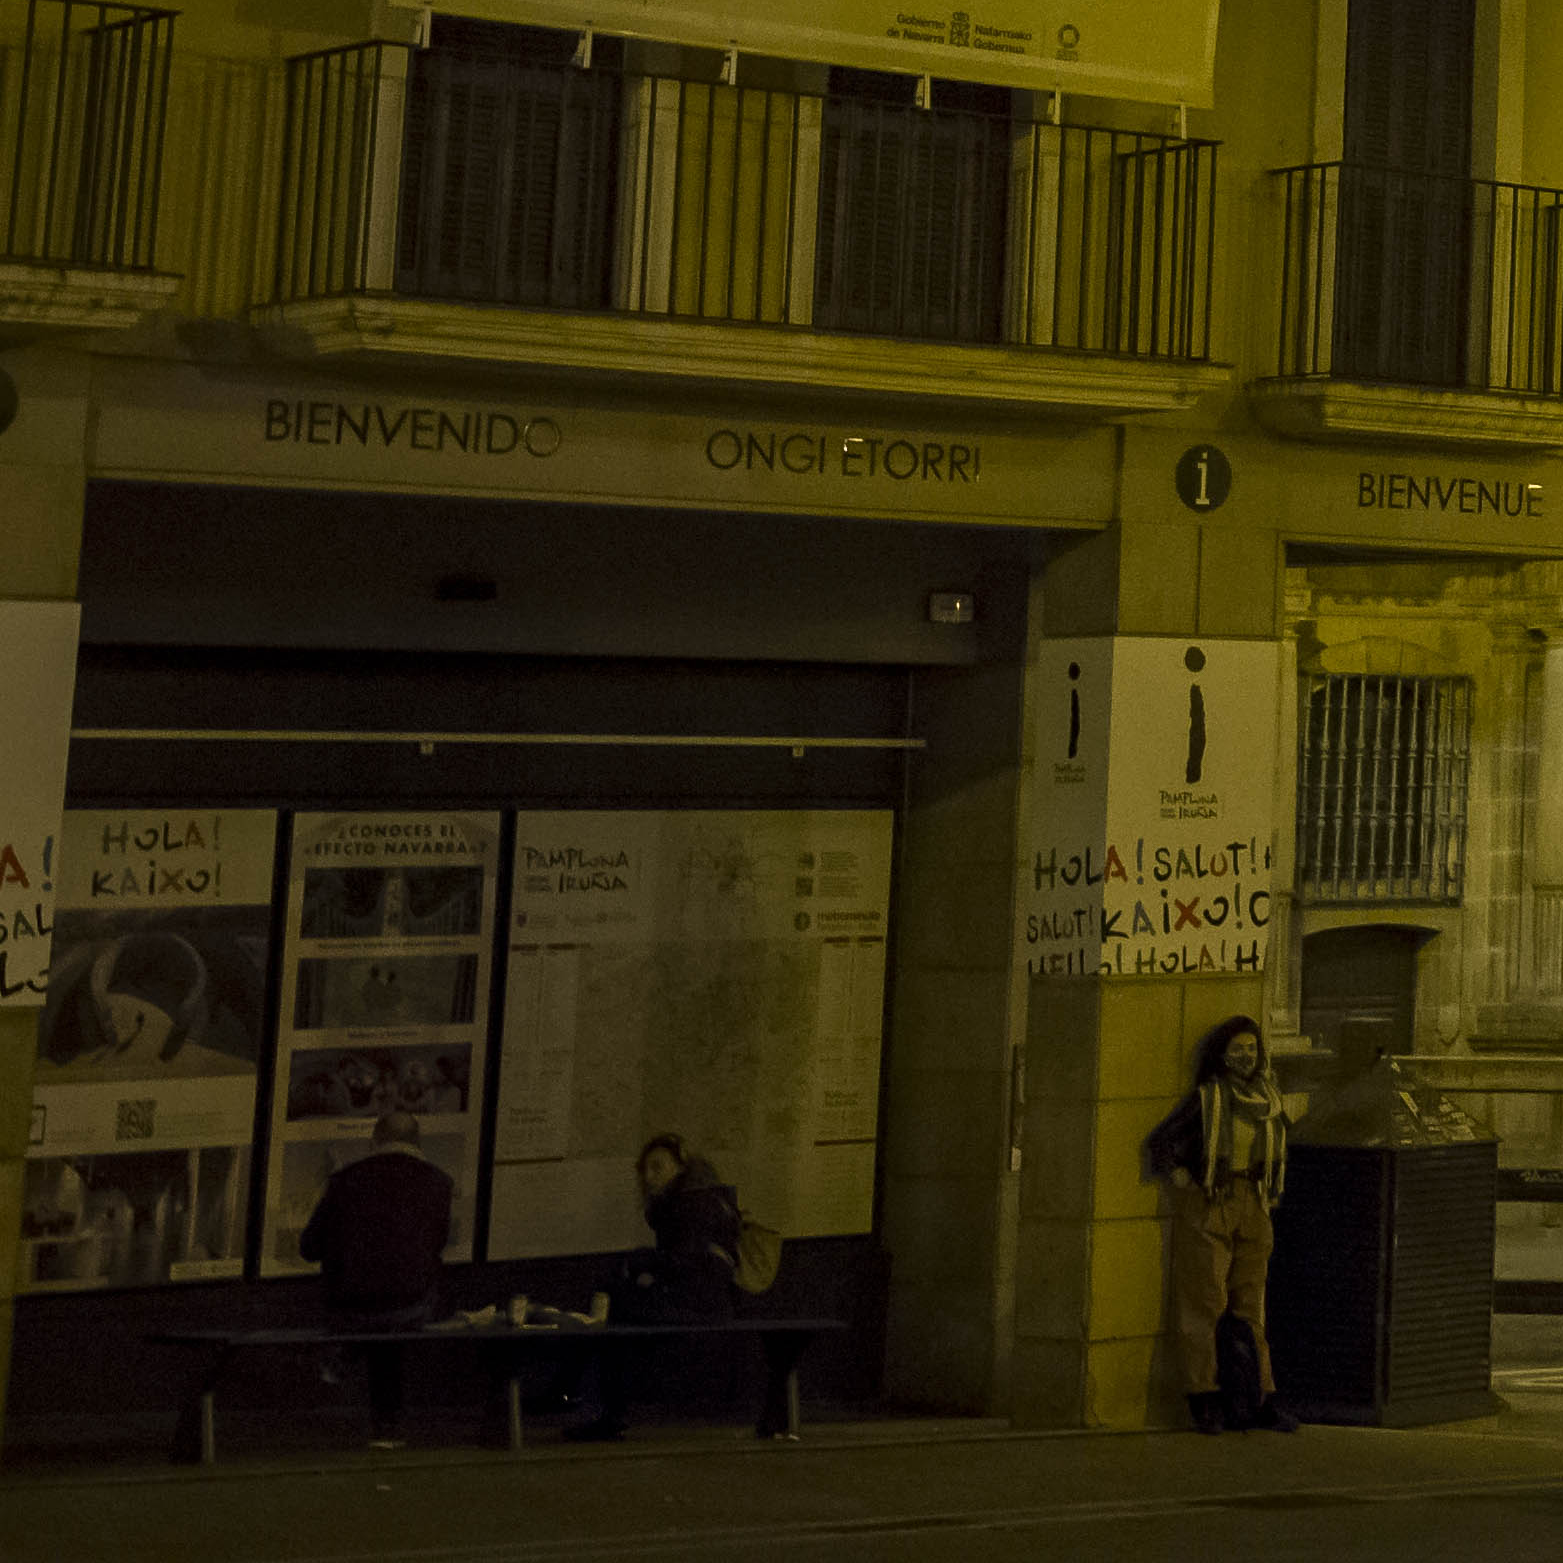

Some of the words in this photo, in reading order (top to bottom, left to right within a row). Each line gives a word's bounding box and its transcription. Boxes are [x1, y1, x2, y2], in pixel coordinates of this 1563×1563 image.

[265, 400, 562, 458] BIENVENIDO
[706, 430, 826, 475] ONGI
[842, 437, 982, 483] ETORRI
[1357, 473, 1544, 517] BIENVENUE
[1159, 790, 1218, 805] PAMPLONA
[102, 816, 221, 854] HOLA!
[523, 847, 629, 870] PAMPLONA
[1034, 838, 1144, 890] HOLA!
[1154, 837, 1256, 882] SALUT!
[1027, 904, 1094, 943] SALUT!
[1136, 939, 1226, 974] HOLA!
